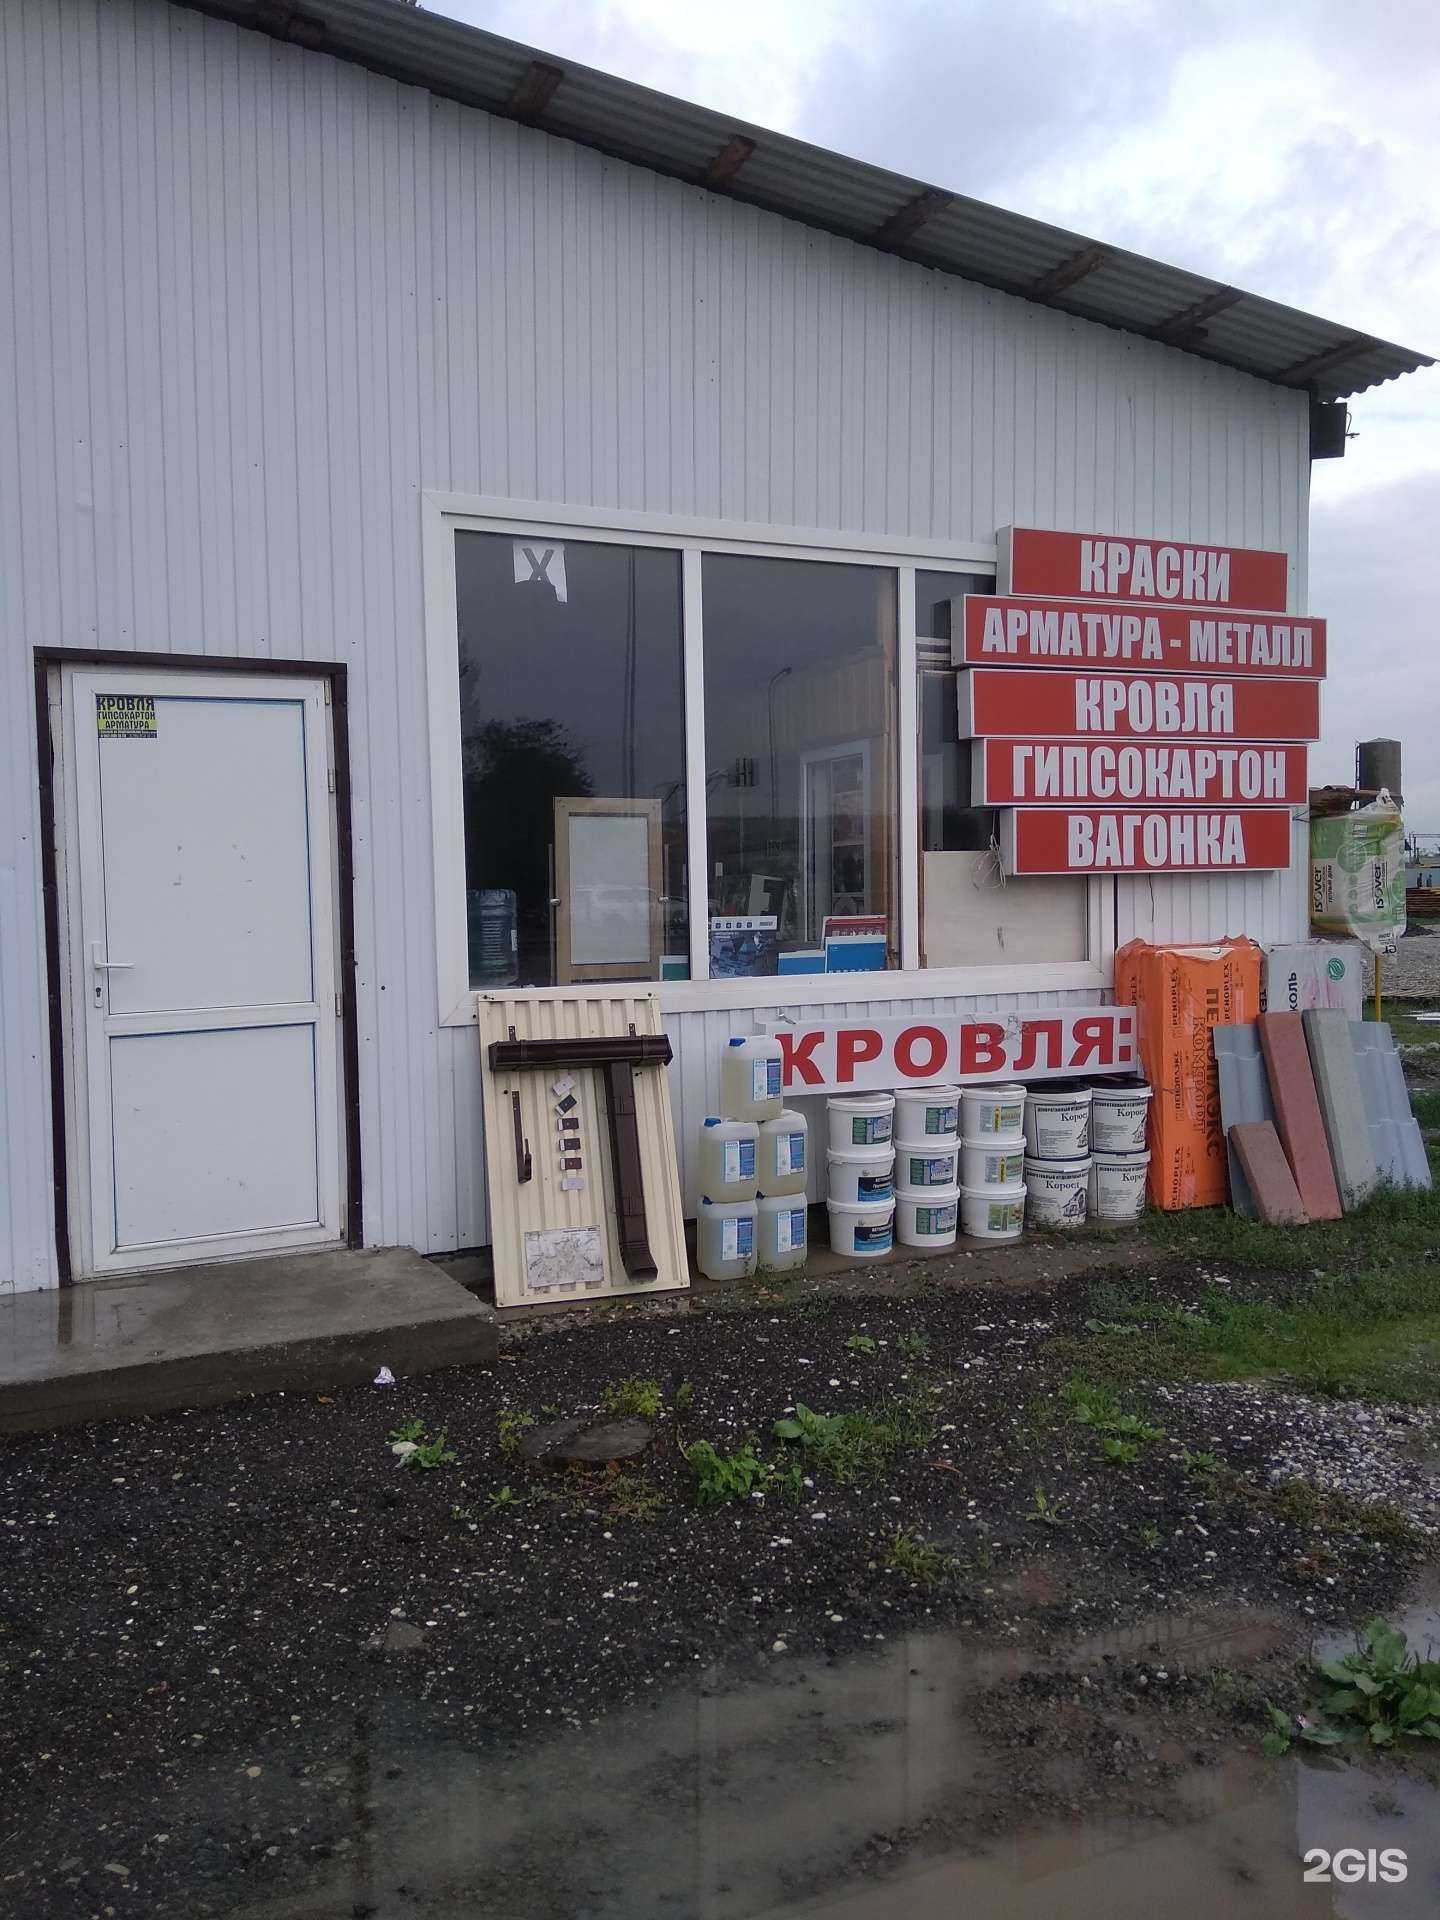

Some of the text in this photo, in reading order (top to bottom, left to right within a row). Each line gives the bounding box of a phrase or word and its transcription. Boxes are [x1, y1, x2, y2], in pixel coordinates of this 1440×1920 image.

[1080, 540, 1231, 602] КРАСКИ
[982, 607, 1313, 668] АРМАТУРА - МЕТАЛЛ
[96, 697, 155, 711] КРОВЛЯ
[97, 711, 156, 721] ГИПСОКАРТОН
[105, 720, 150, 730] АРМАТУРА
[1075, 679, 1234, 733] КРОВЛЯ
[1012, 745, 1286, 799] ГИПСОКАРТОН
[1067, 815, 1246, 867] ВАГОНКА
[775, 1016, 1132, 1086] КРОВЛЯ:
[1191, 1016, 1207, 1133] КОМФОРТ
[1045, 1180, 1080, 1191] Короед
